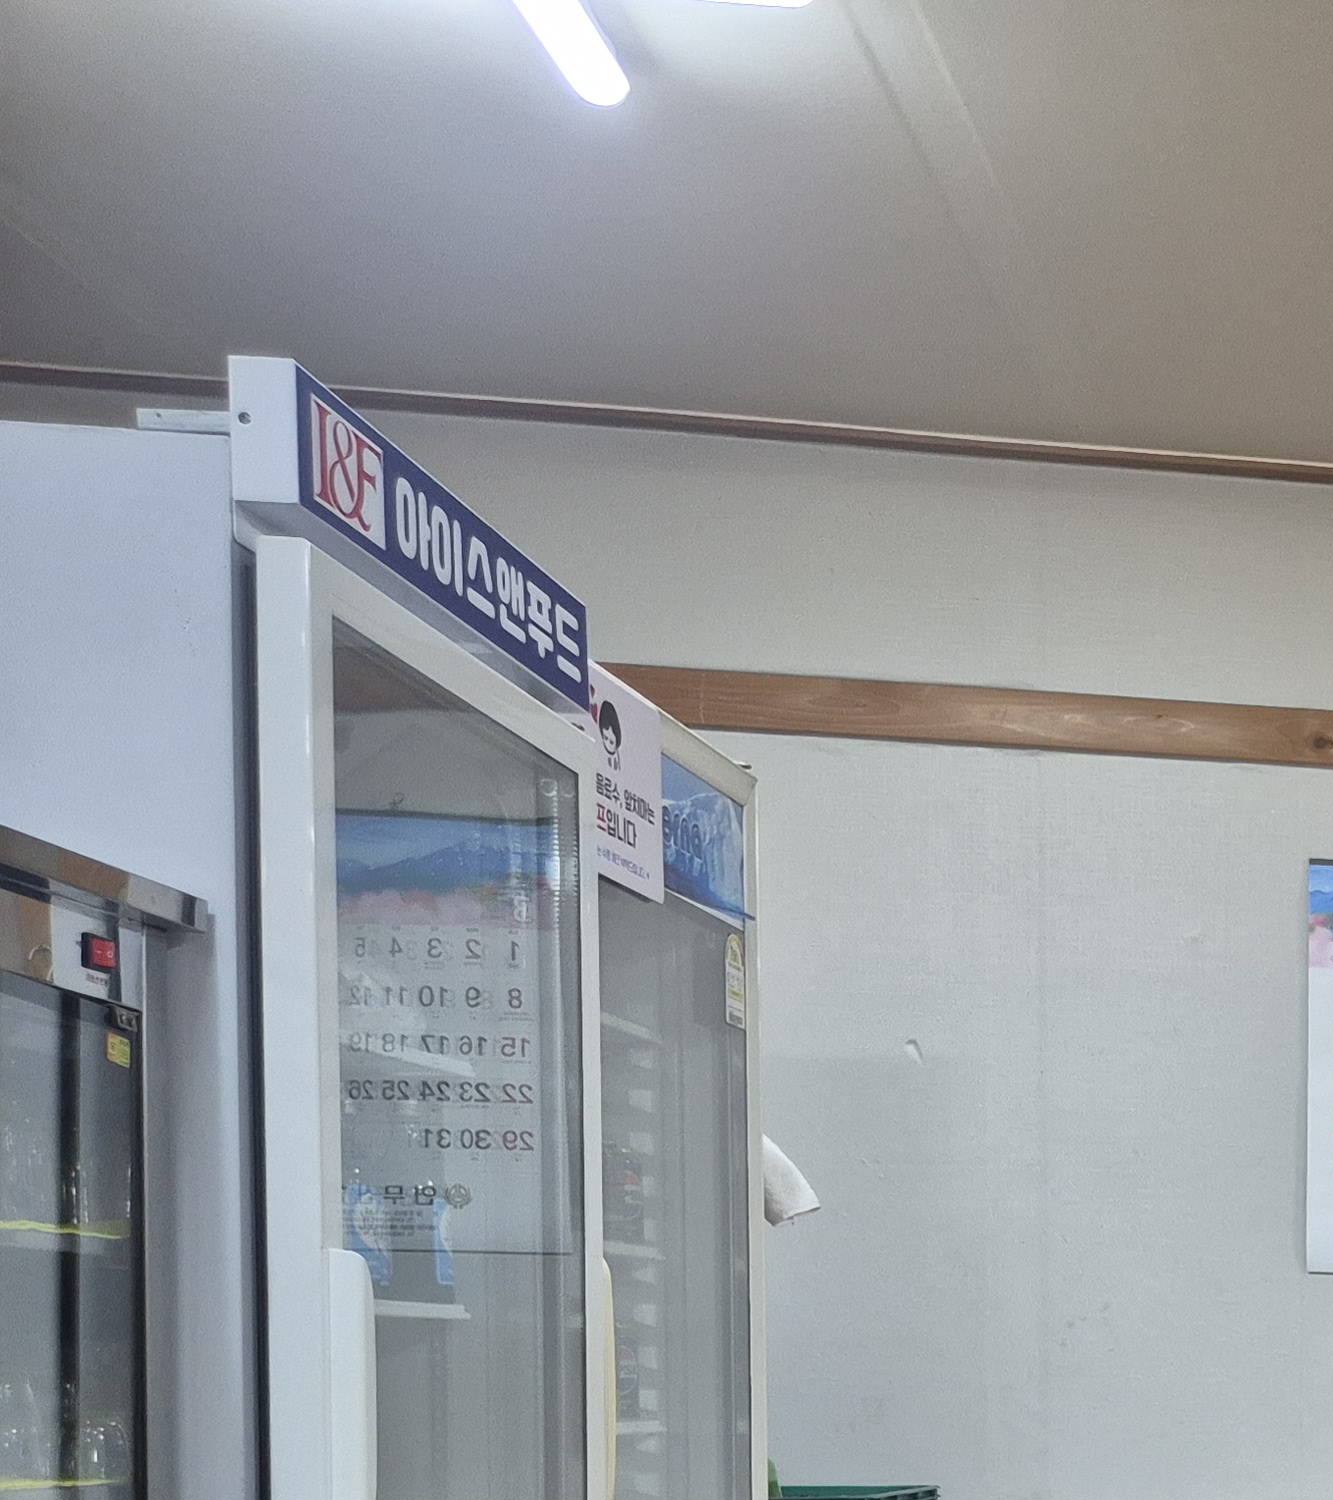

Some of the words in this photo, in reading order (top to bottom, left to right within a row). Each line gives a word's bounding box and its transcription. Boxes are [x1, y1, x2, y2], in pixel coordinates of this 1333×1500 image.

[313, 398, 383, 533] I&F
[395, 477, 582, 683] 아이스앤푸드
[596, 802, 637, 849] 프입니다
[624, 789, 655, 825] 앞치마는
